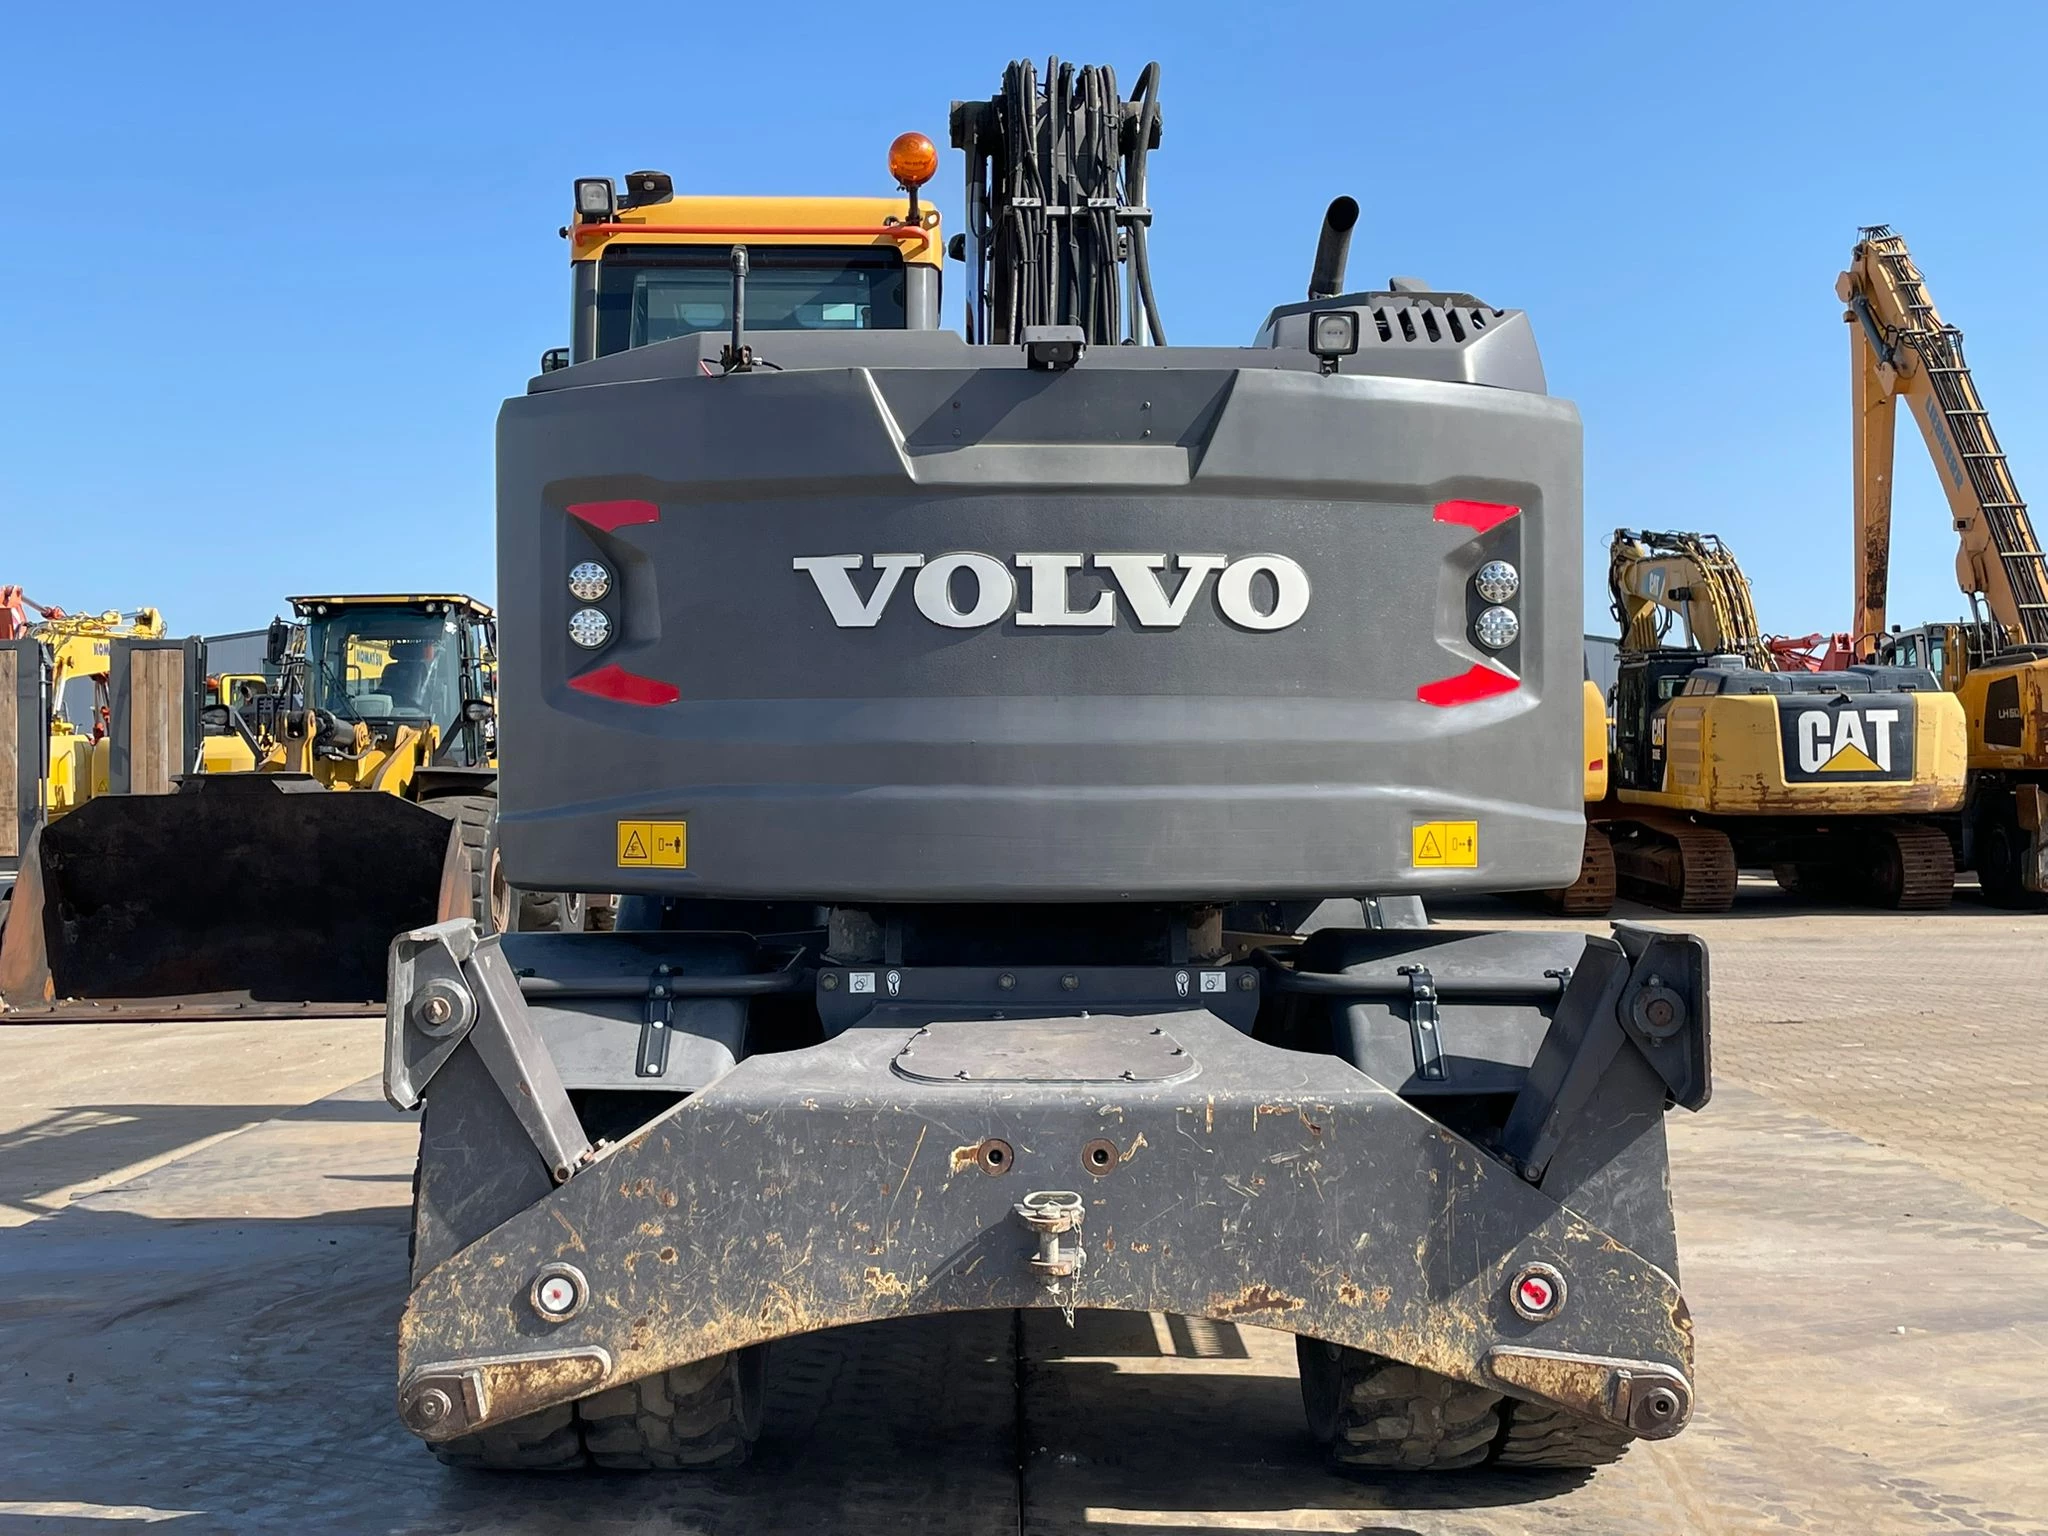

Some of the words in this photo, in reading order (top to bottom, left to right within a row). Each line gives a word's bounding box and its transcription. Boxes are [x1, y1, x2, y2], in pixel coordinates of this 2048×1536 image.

[792, 553, 1311, 630] VOLVO
[93, 642, 110, 656] KOM
[1652, 718, 1666, 746] CAT
[1798, 709, 1899, 773] CAT
